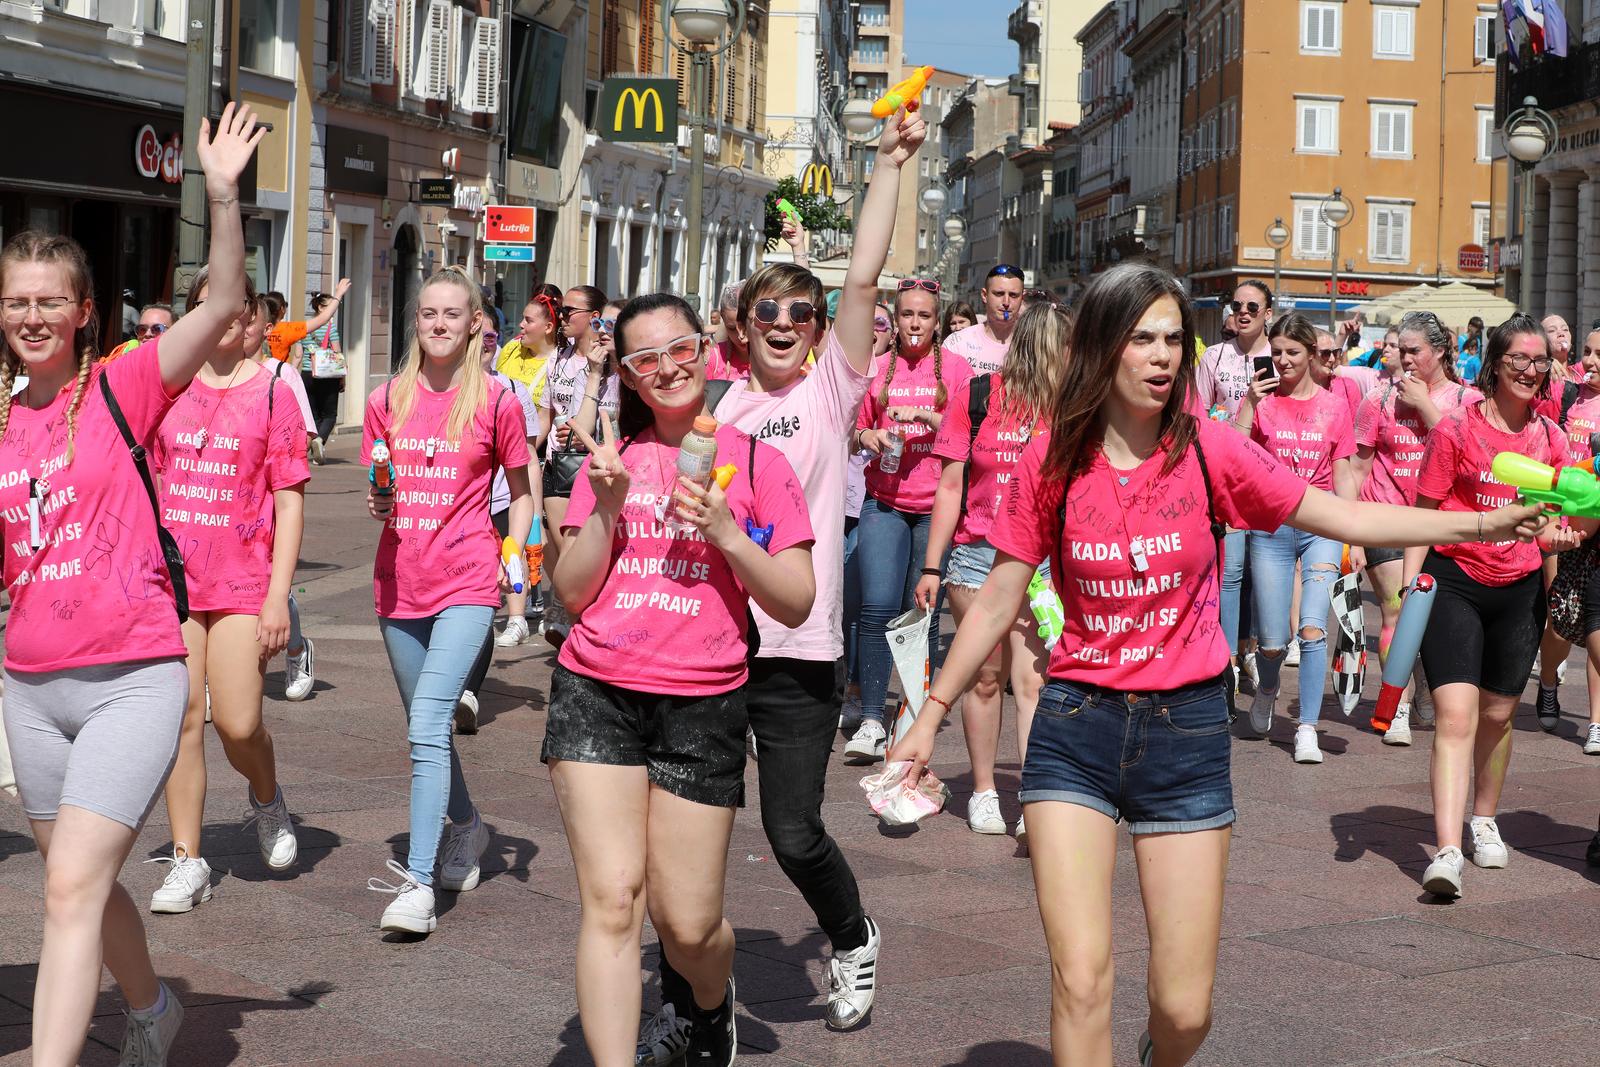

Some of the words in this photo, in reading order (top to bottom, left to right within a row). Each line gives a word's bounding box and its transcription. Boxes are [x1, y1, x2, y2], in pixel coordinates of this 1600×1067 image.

[500, 223, 530, 234] Lutrija
[1460, 258, 1484, 268] KING
[1324, 280, 1370, 296] TSAK
[979, 360, 1003, 371] sestr
[1220, 371, 1231, 382] 22
[915, 386, 937, 397] ŽENE
[1396, 418, 1419, 428] KADA
[1573, 418, 1596, 430] KADA
[176, 432, 208, 449] KA
[213, 433, 241, 451] ŽENE
[997, 431, 1020, 442] KAD
[1301, 430, 1323, 442] ŽENE
[1393, 435, 1426, 444] TULUM
[394, 437, 426, 451] KADA
[911, 443, 934, 453] PRAV
[1395, 451, 1424, 463] NAJBO
[174, 457, 238, 477] TULUMARE
[1393, 468, 1411, 478] ZUBI
[0, 468, 31, 490] ADA
[169, 483, 218, 504] NAJBOLJI
[220, 489, 234, 502] SE
[441, 493, 455, 506] SE
[625, 492, 655, 505] KAD
[164, 508, 191, 523] ZUBI
[194, 512, 230, 527] PRAVE
[388, 516, 413, 530] ZUBI
[65, 522, 82, 541] SE
[1071, 540, 1123, 561] KADA
[1134, 531, 1183, 556] ENE
[41, 558, 82, 582] PRAVE
[616, 557, 688, 580] NAJBOLJI
[690, 562, 710, 581] SE
[1075, 571, 1183, 598] TULUMARE
[648, 591, 702, 617] PRAVE
[1082, 610, 1155, 638] NAJBOLJI
[1158, 607, 1179, 627] SE
